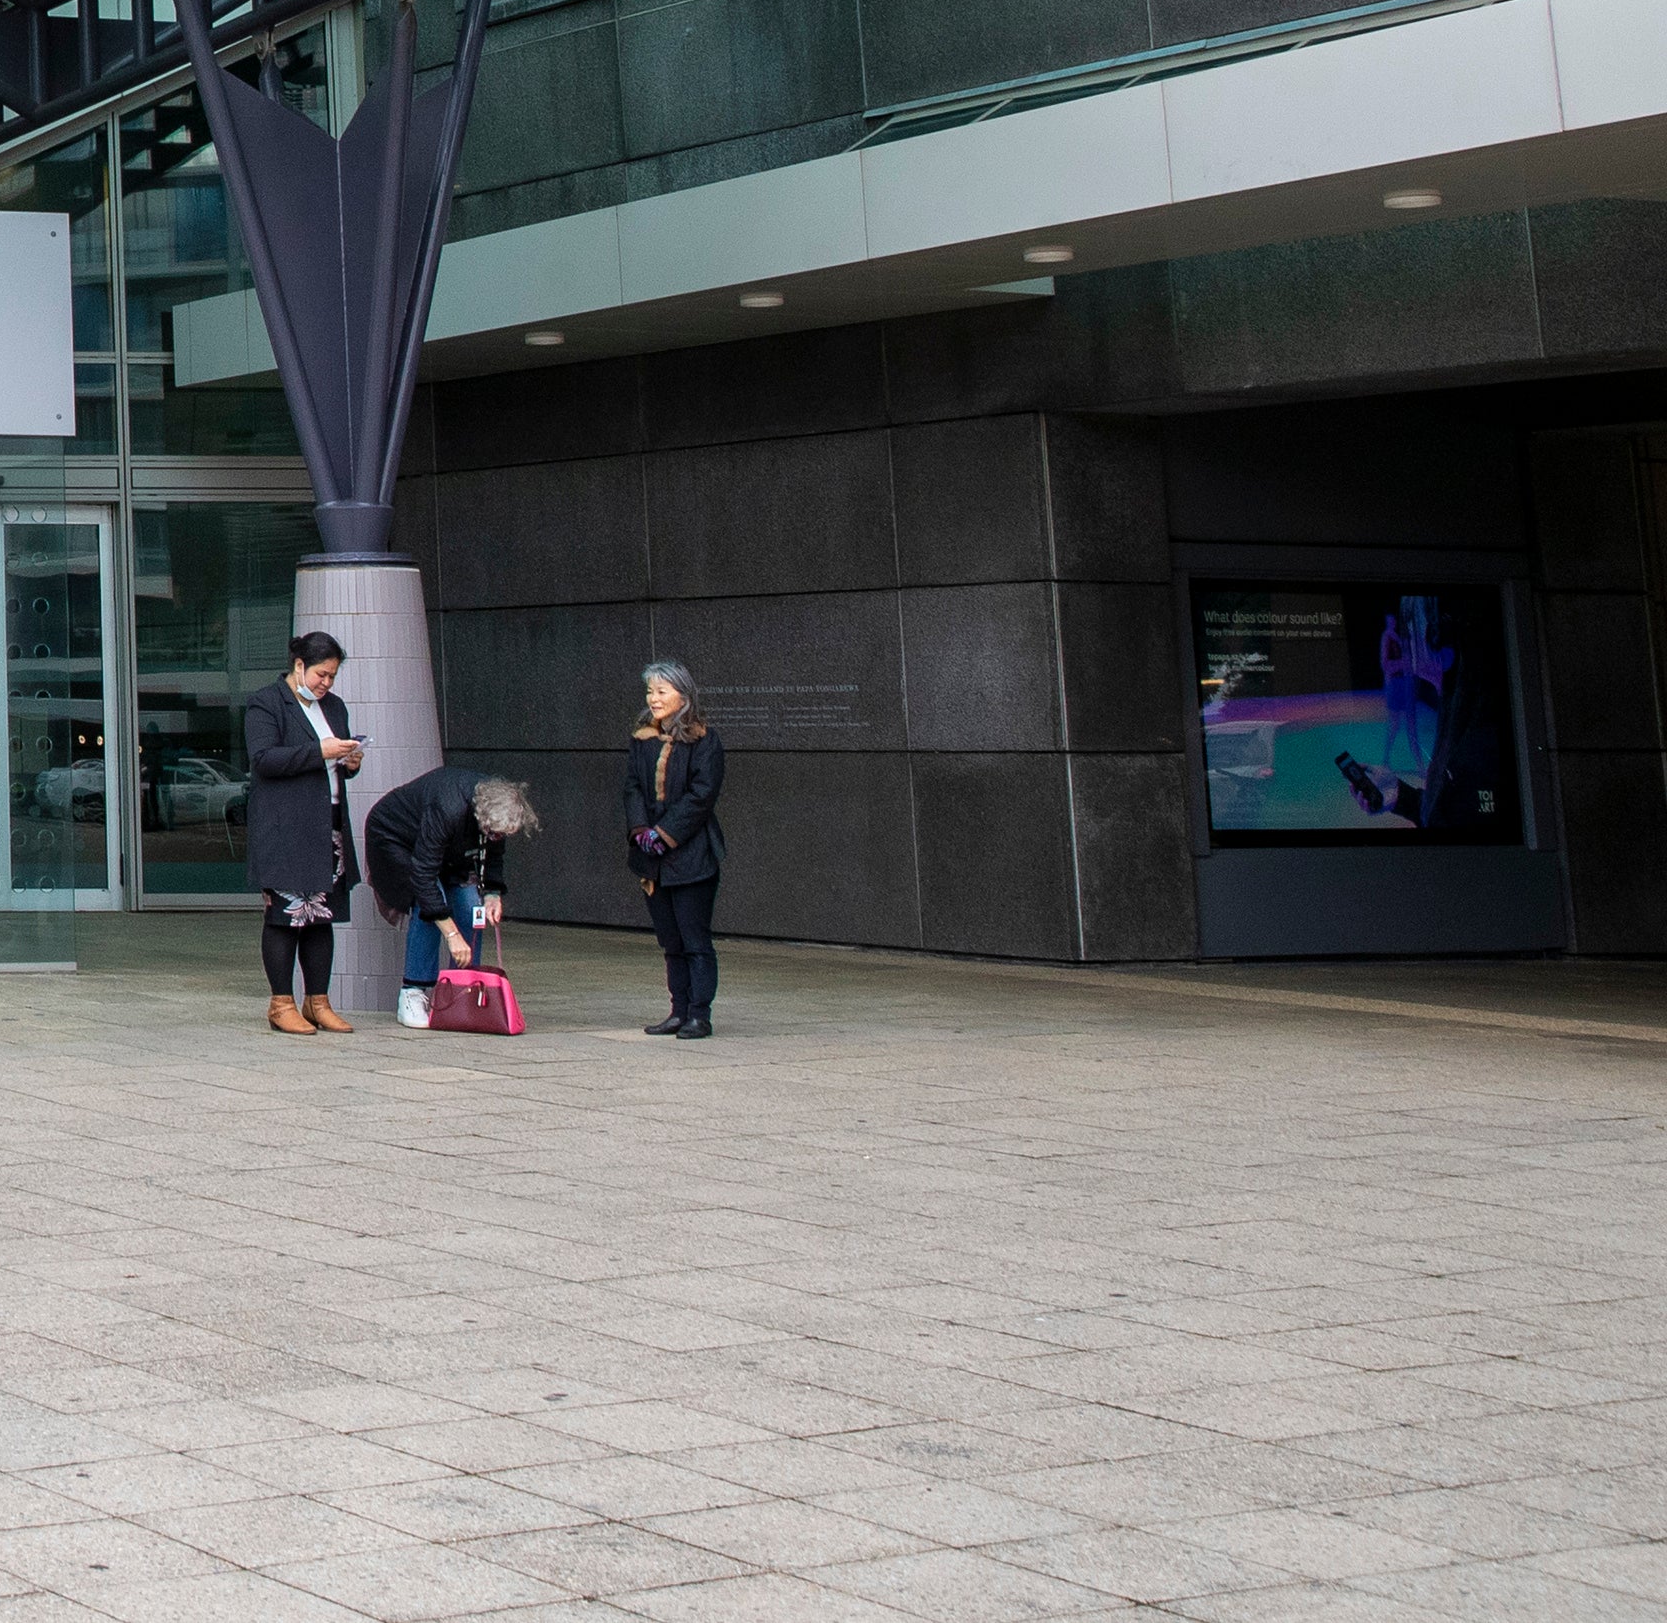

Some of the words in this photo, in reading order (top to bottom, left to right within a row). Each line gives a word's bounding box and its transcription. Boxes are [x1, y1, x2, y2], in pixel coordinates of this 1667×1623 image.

[1203, 609, 1230, 623] What
[1231, 610, 1255, 624] does
[1256, 611, 1287, 624] colour
[1289, 611, 1318, 625] sound
[1320, 611, 1343, 625] like?
[1477, 789, 1494, 801] TOI
